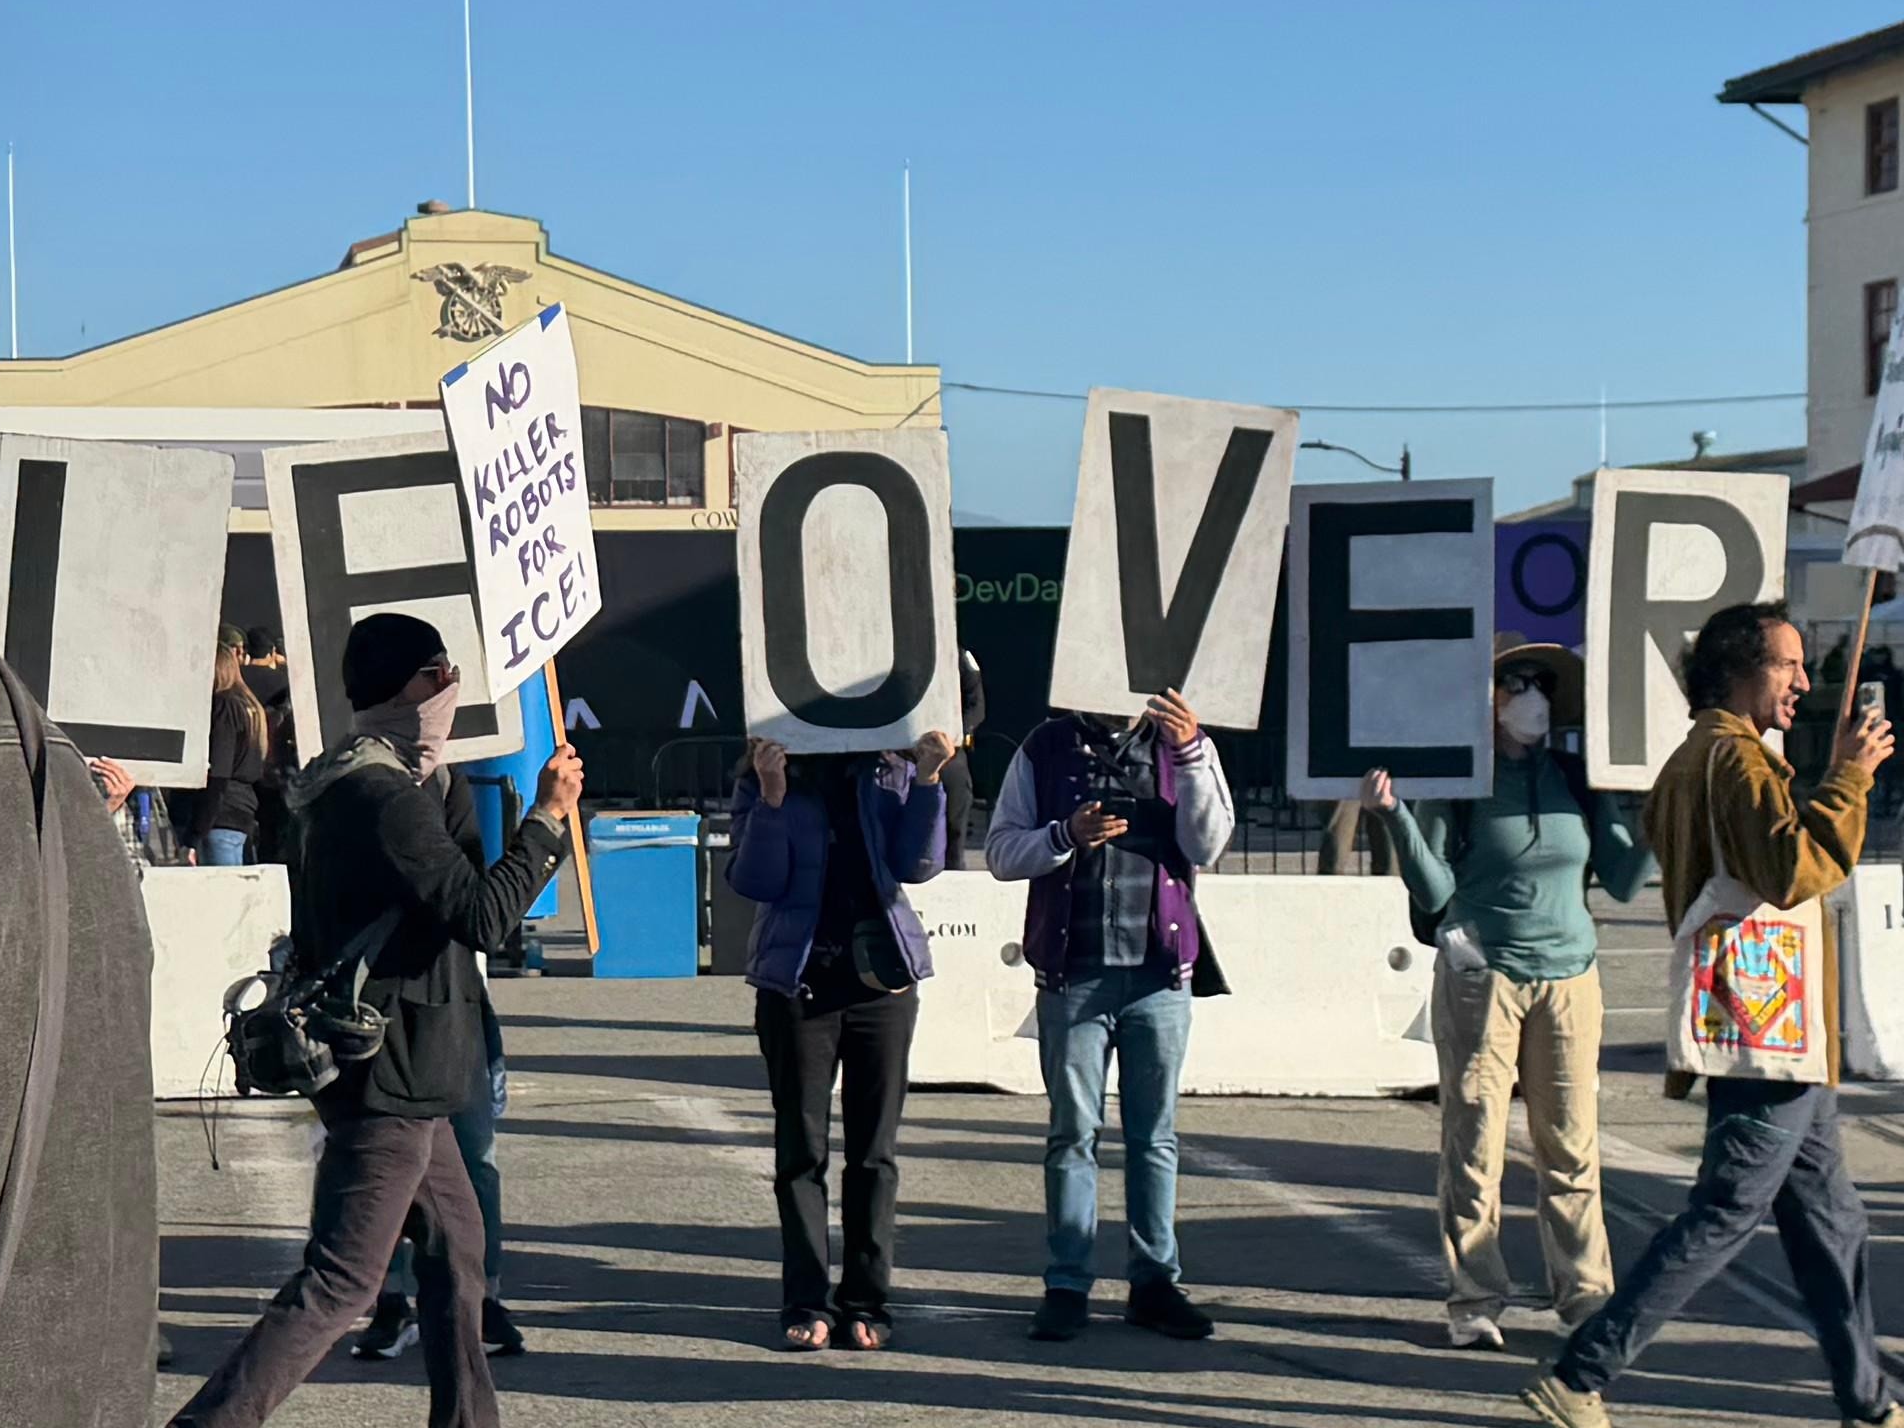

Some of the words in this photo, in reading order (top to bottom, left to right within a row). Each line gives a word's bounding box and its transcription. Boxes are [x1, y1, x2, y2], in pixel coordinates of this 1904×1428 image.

[485, 362, 531, 430] NO
[474, 412, 568, 520] KILLER
[490, 452, 576, 556] ROBOTS
[518, 524, 566, 586] FOR
[954, 573, 1064, 602] DevDa
[501, 552, 587, 670] ICE!
